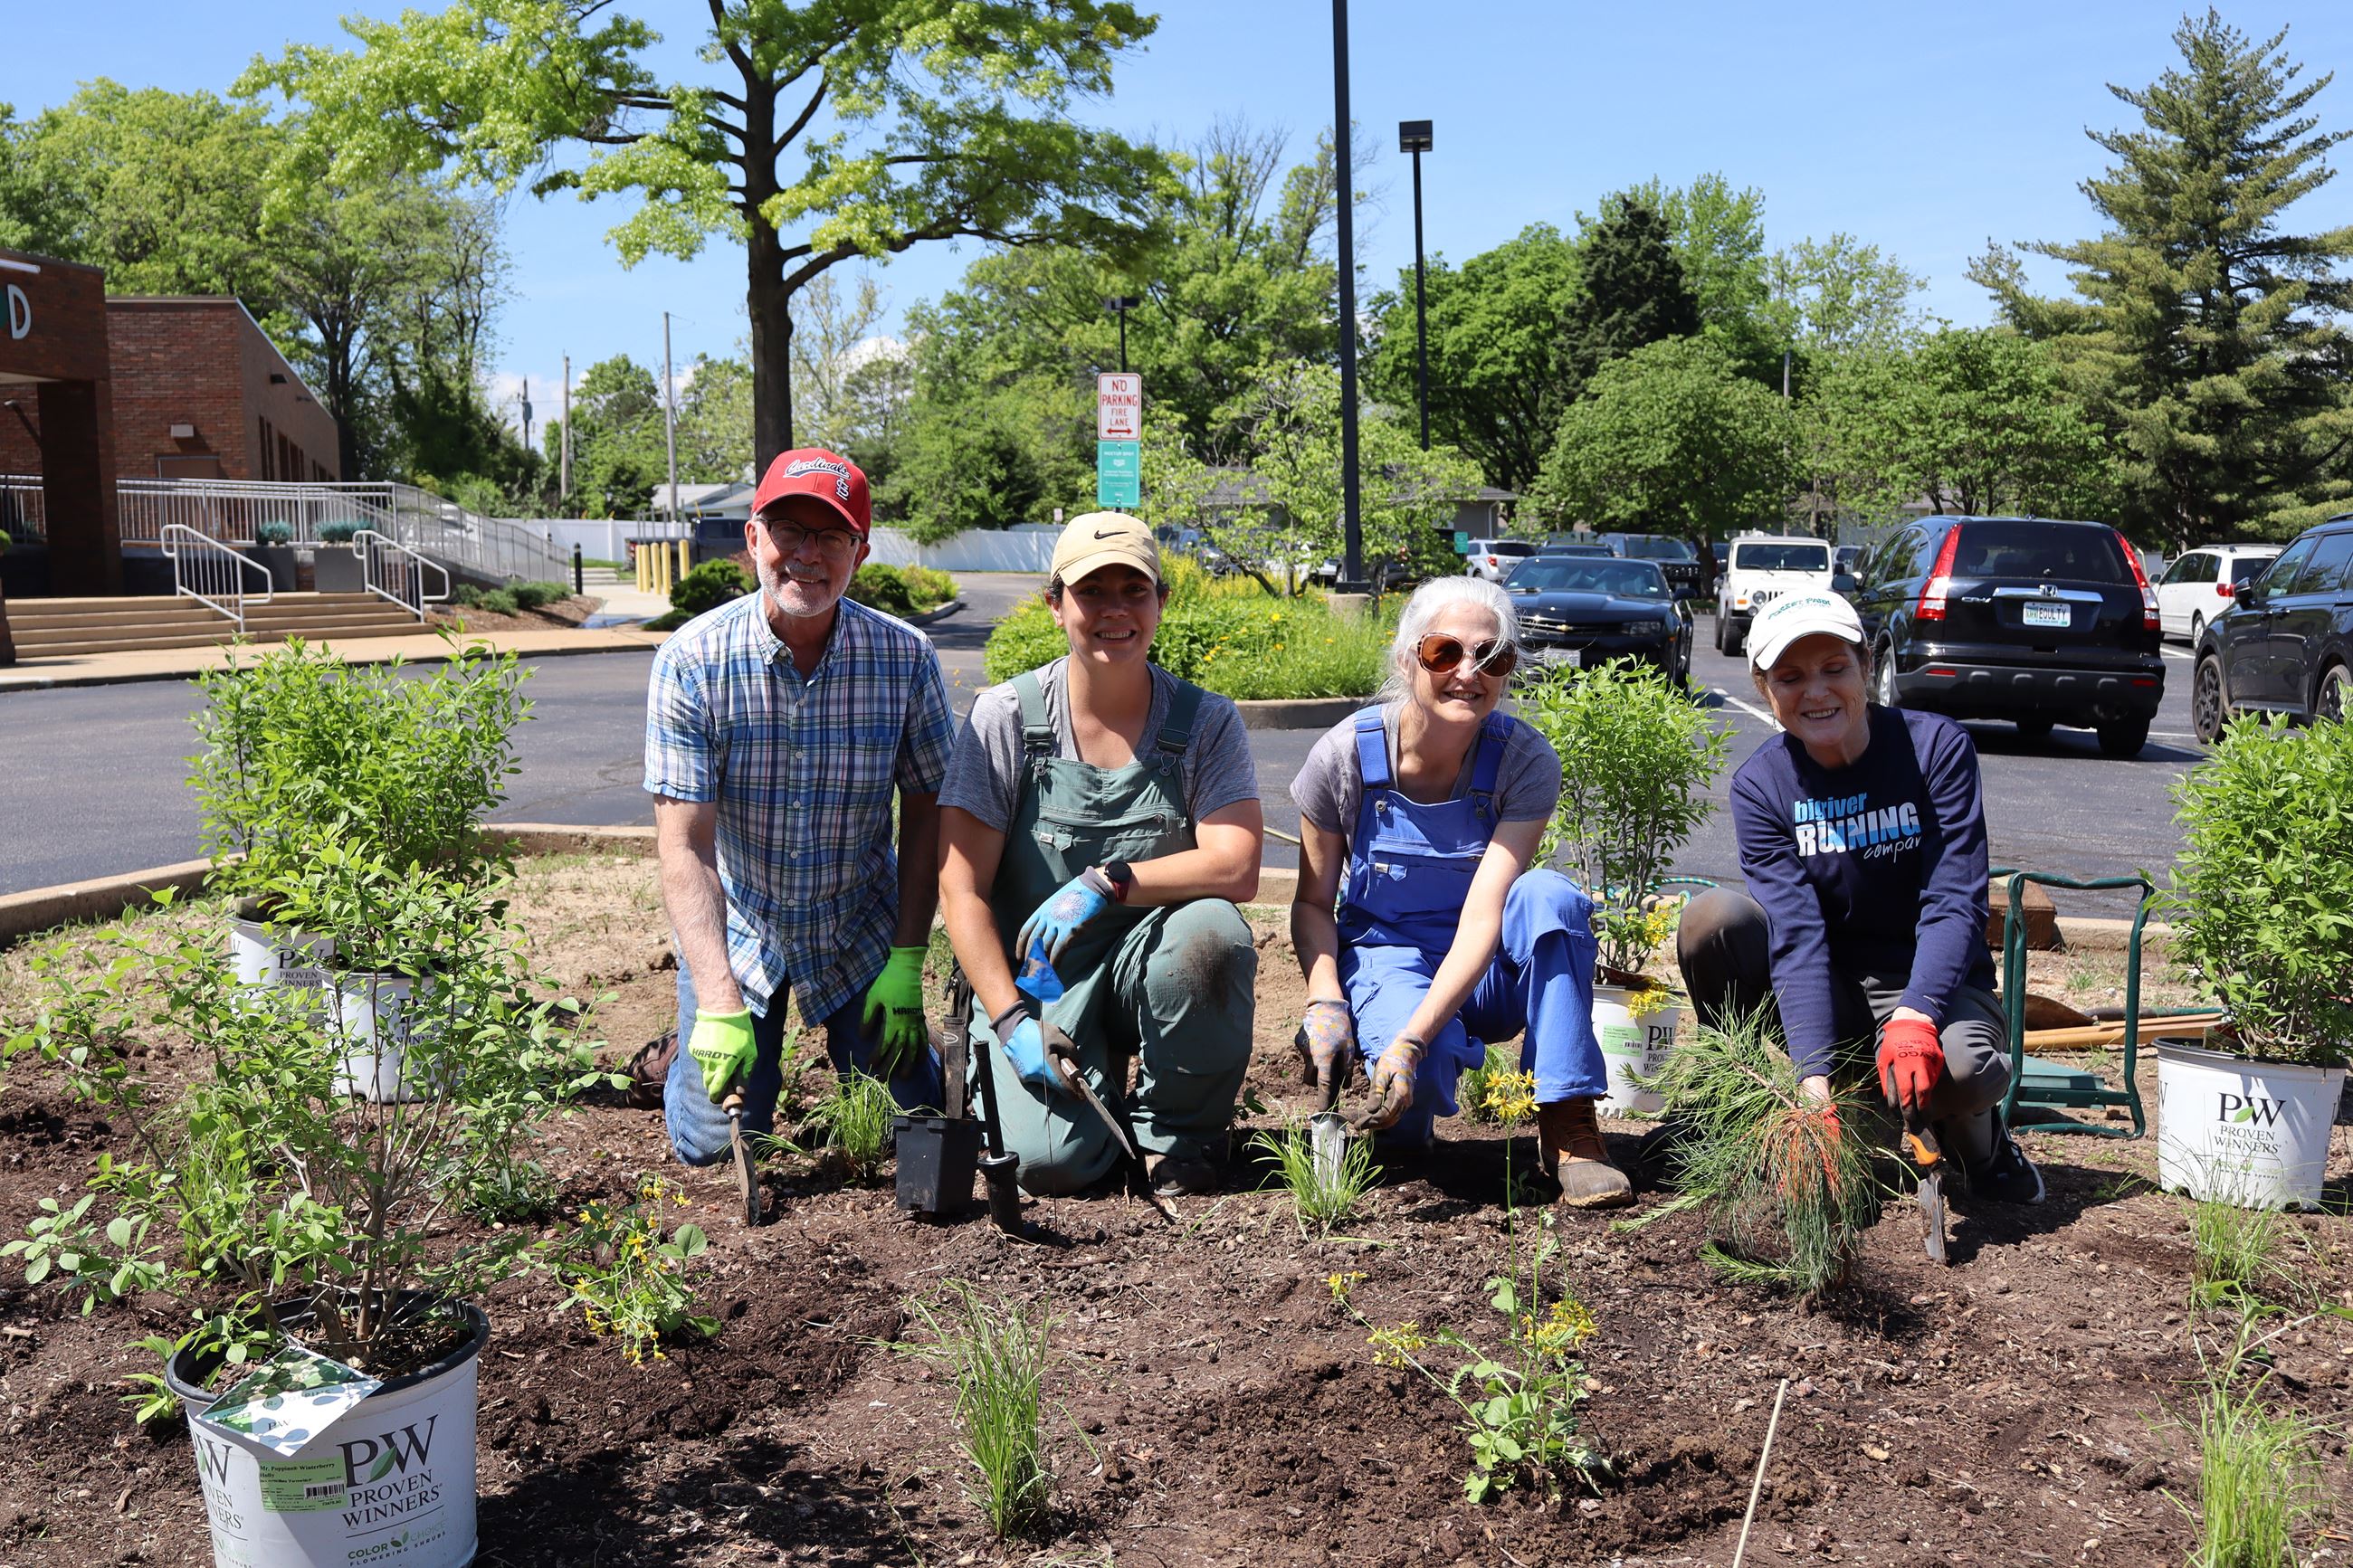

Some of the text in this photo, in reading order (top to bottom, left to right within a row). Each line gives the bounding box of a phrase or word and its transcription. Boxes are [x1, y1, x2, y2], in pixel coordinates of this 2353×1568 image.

[1112, 380, 1127, 392] NO
[1102, 394, 1138, 406] PARKING
[1111, 408, 1128, 416] FIRE
[1110, 418, 1129, 426] LANE
[280, 971, 318, 979] PROVEN
[2220, 1125, 2275, 1141] PROVEN
[2215, 1136, 2279, 1154] WINNERS
[350, 1468, 433, 1508] PROVEN
[342, 1485, 440, 1527] WINNERS
[348, 1522, 447, 1559] COLOR CHOICE
[349, 1531, 446, 1567] FLOWERING SHRUBS
